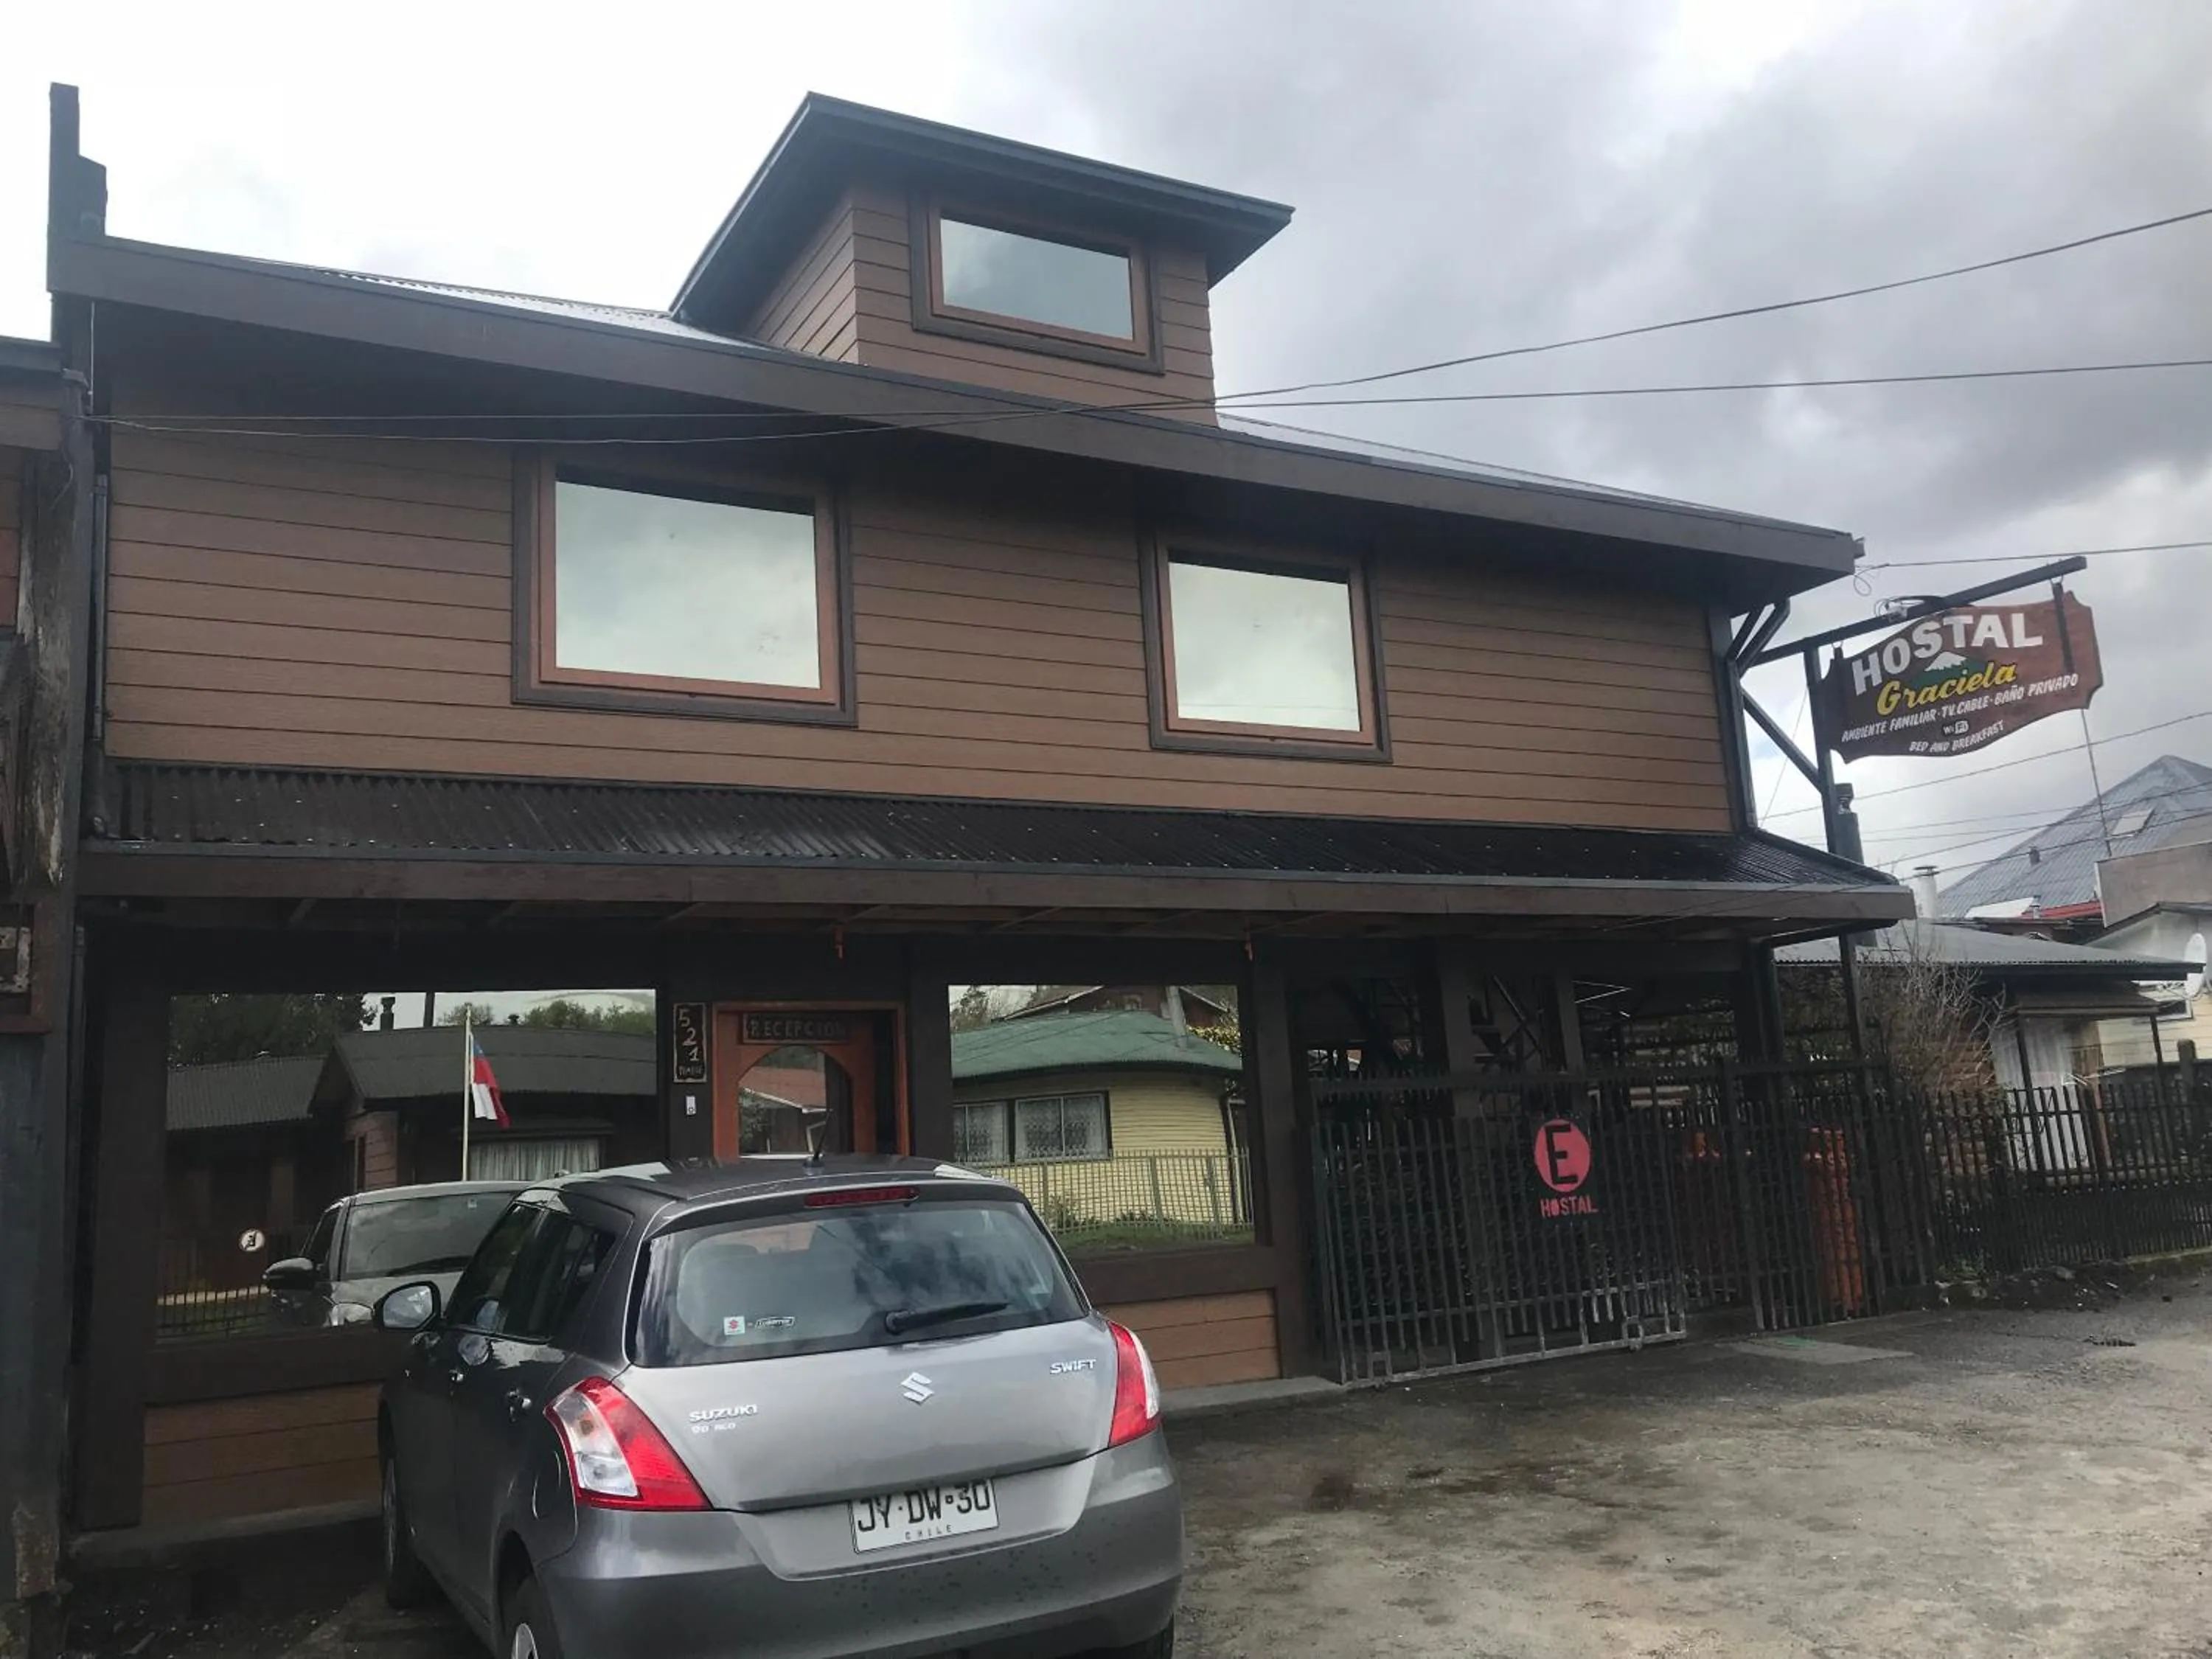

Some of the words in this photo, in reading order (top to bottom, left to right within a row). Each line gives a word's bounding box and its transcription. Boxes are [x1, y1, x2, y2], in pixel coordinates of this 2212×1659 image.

[1851, 613, 2044, 696] HOSTAL
[1877, 661, 2017, 716] Graciela
[1841, 720, 1887, 742] AMBIENTE
[1889, 709, 1937, 731] FAMILIAR
[1994, 685, 2025, 706] BAÑO
[2028, 673, 2079, 696] PRIVADO
[1909, 741, 1929, 752] BED
[1930, 742, 1950, 753] AND
[1952, 720, 2004, 751] BREAKFAST
[1545, 1123, 1579, 1185] E
[1540, 1195, 1599, 1219] HOSTAL
[1050, 1358, 1097, 1374] SWIFT
[689, 1404, 759, 1422] SUZUKI
[905, 1523, 952, 1540] CHILE
